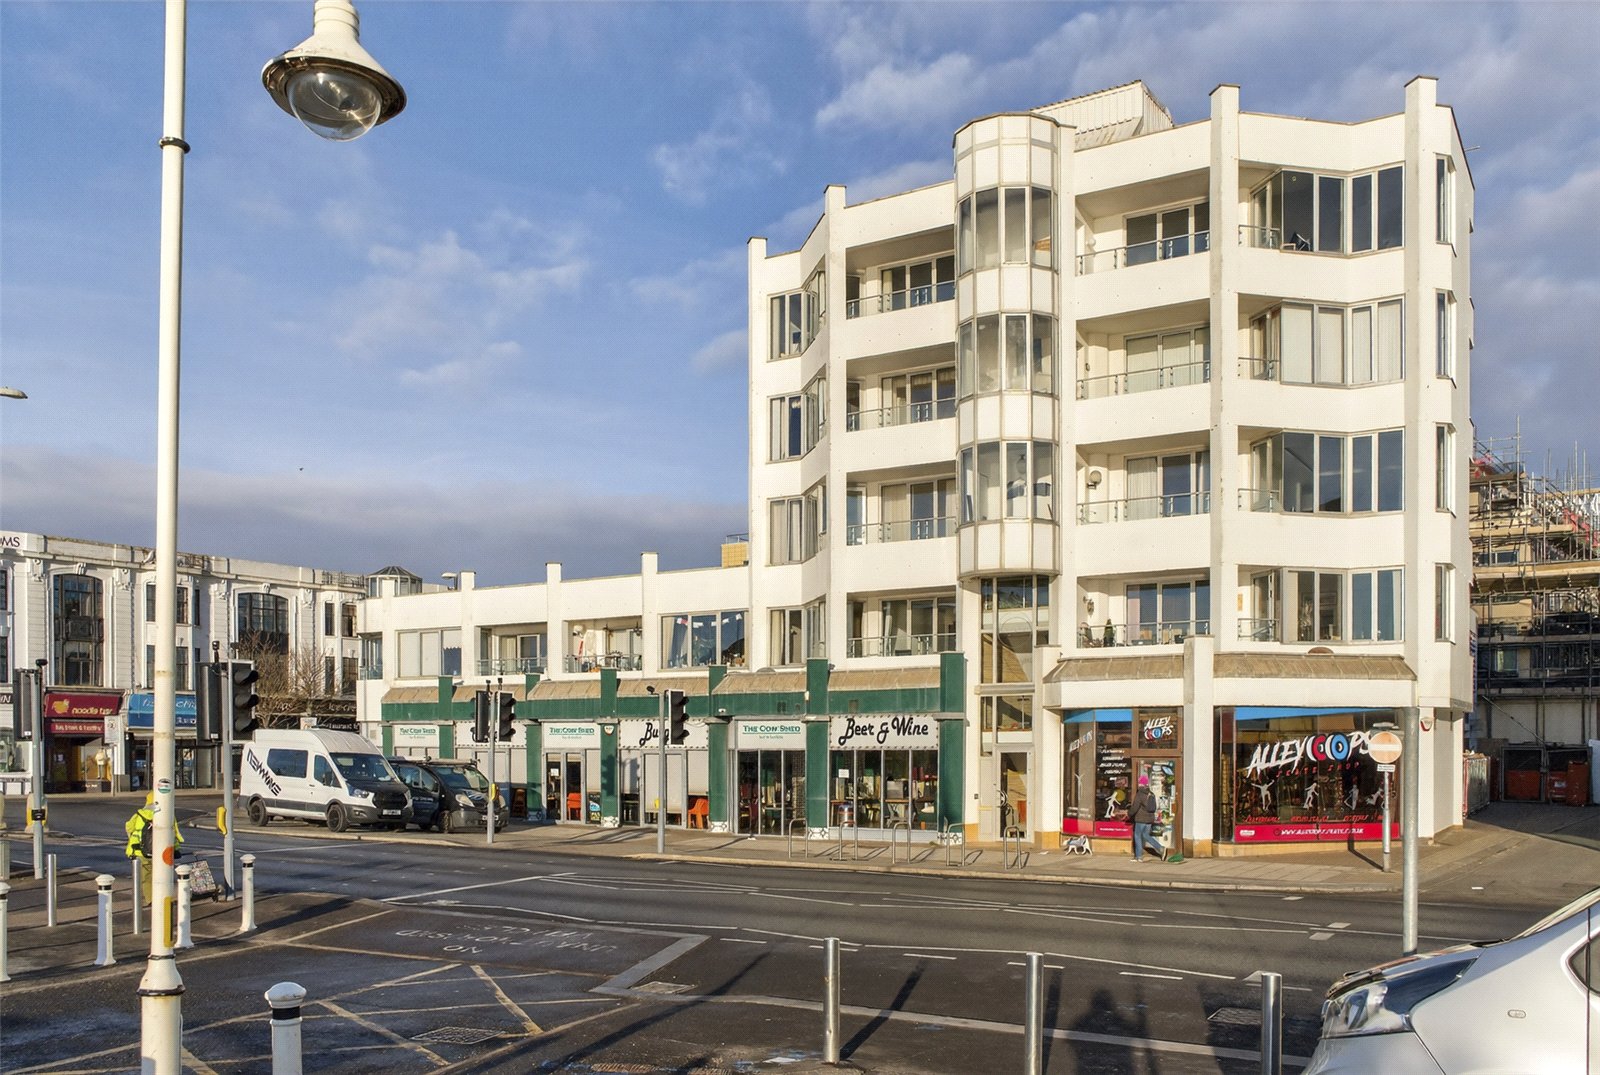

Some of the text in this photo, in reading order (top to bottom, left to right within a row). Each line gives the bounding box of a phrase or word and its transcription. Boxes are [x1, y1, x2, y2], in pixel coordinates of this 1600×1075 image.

[838, 716, 929, 745] Beer & Wine
[1144, 716, 1171, 731] ALLEY
